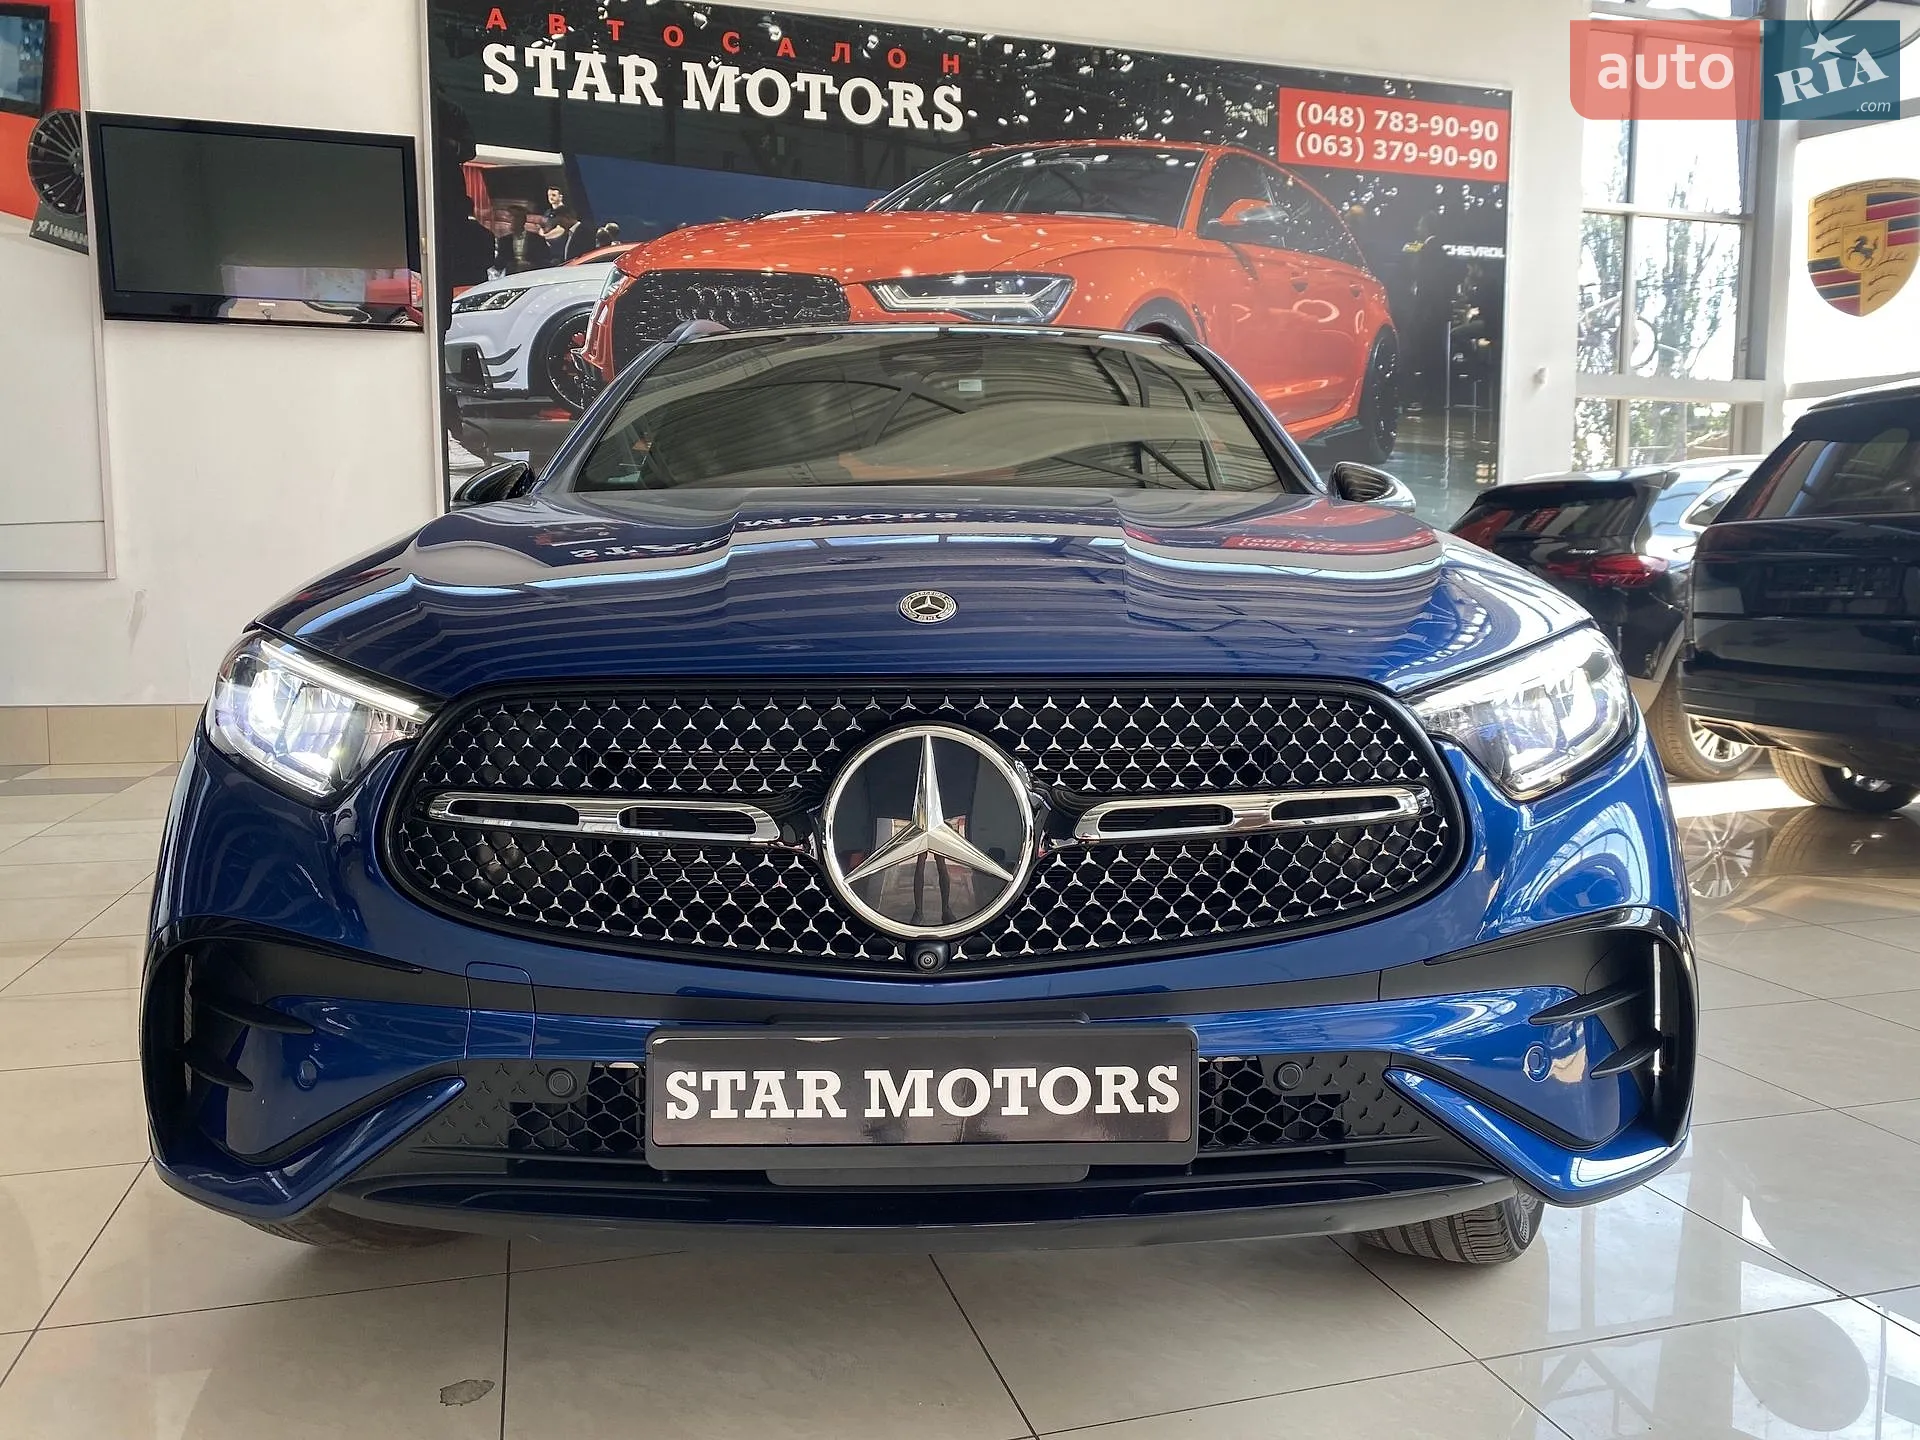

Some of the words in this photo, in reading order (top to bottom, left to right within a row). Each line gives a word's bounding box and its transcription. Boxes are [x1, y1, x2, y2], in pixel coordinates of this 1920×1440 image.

[482, 42, 664, 107] STAR
[682, 61, 965, 132] MOTORS
[1296, 101, 1365, 133] (048)
[1374, 109, 1498, 141] 783-90-90
[1296, 131, 1364, 163] (063)
[1373, 139, 1498, 170] 379-90-90
[665, 1069, 847, 1120] STAR
[863, 1065, 1180, 1117] MOTORS
